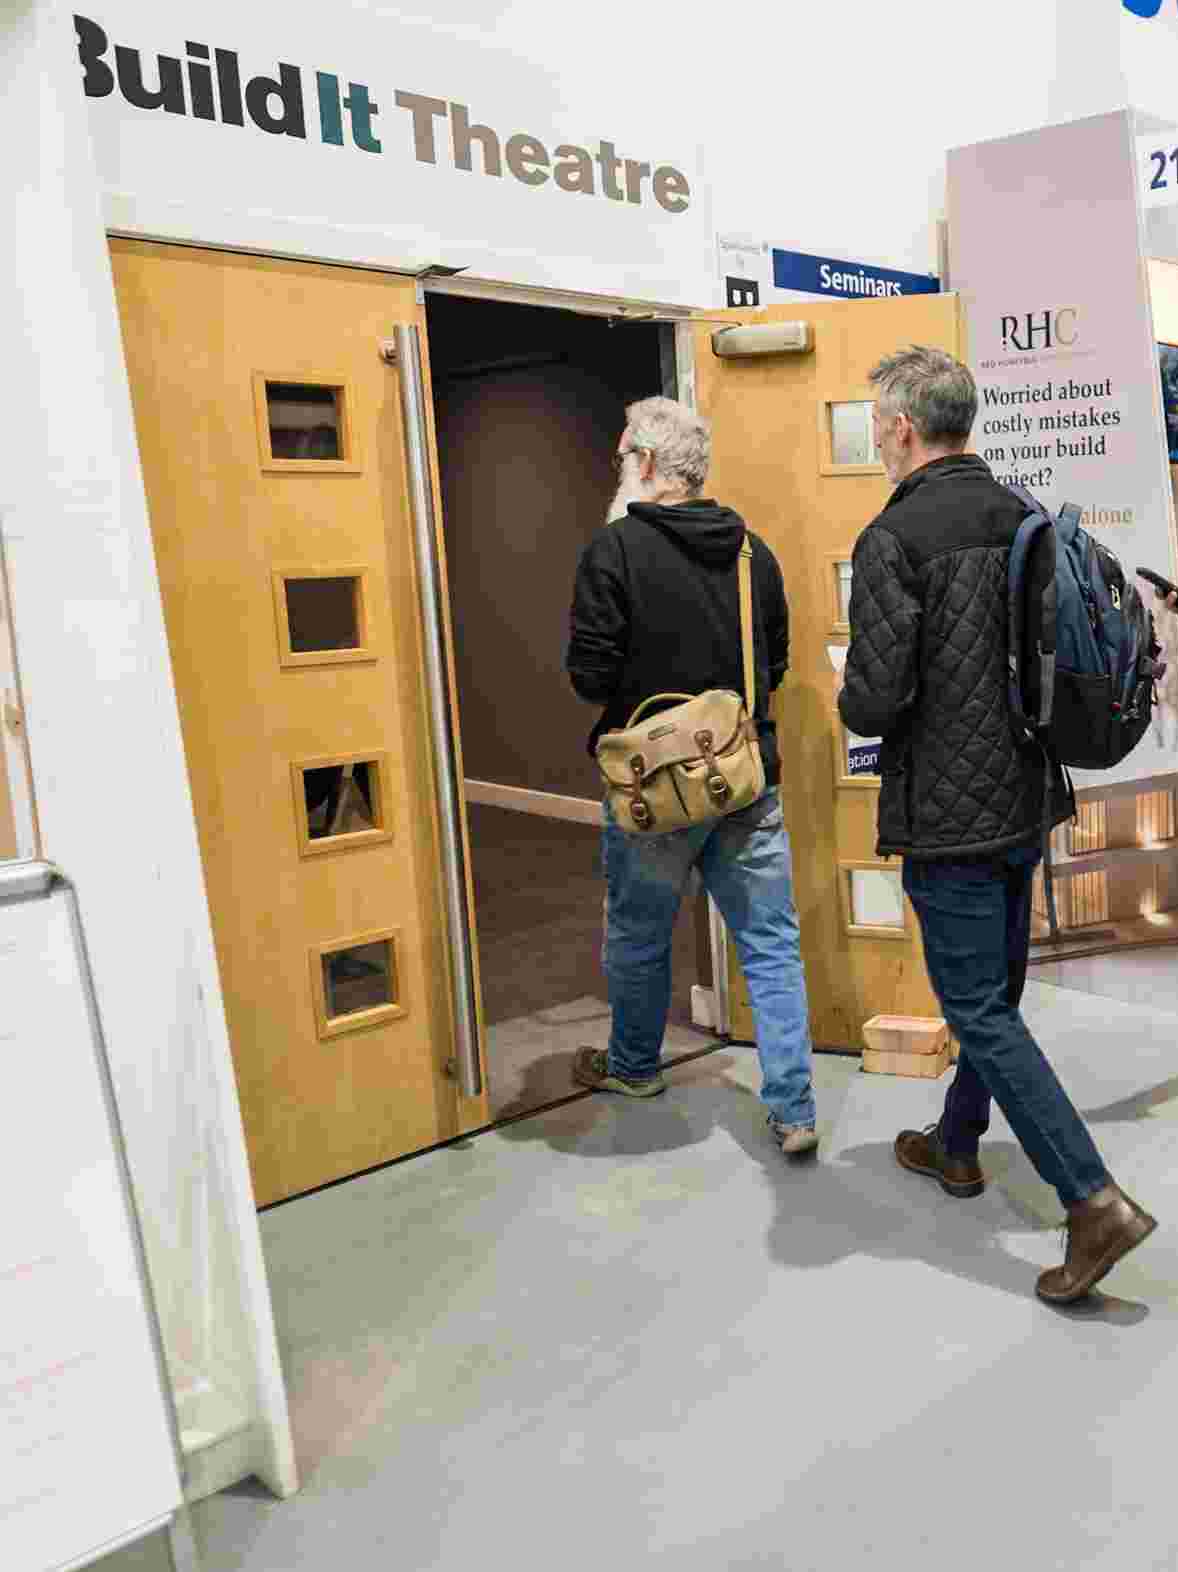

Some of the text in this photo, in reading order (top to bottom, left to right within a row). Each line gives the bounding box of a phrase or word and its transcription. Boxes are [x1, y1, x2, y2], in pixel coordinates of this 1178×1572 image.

[72, 14, 690, 212] Build It Theatre
[820, 264, 903, 297] Seminars
[1000, 308, 1080, 352] RHC
[983, 378, 1112, 407] Worried about
[983, 406, 1121, 438] costly mistakes
[983, 435, 1107, 466] on your build
[994, 466, 1053, 488] roject?
[1080, 503, 1134, 526] alone
[848, 752, 878, 768] ation
